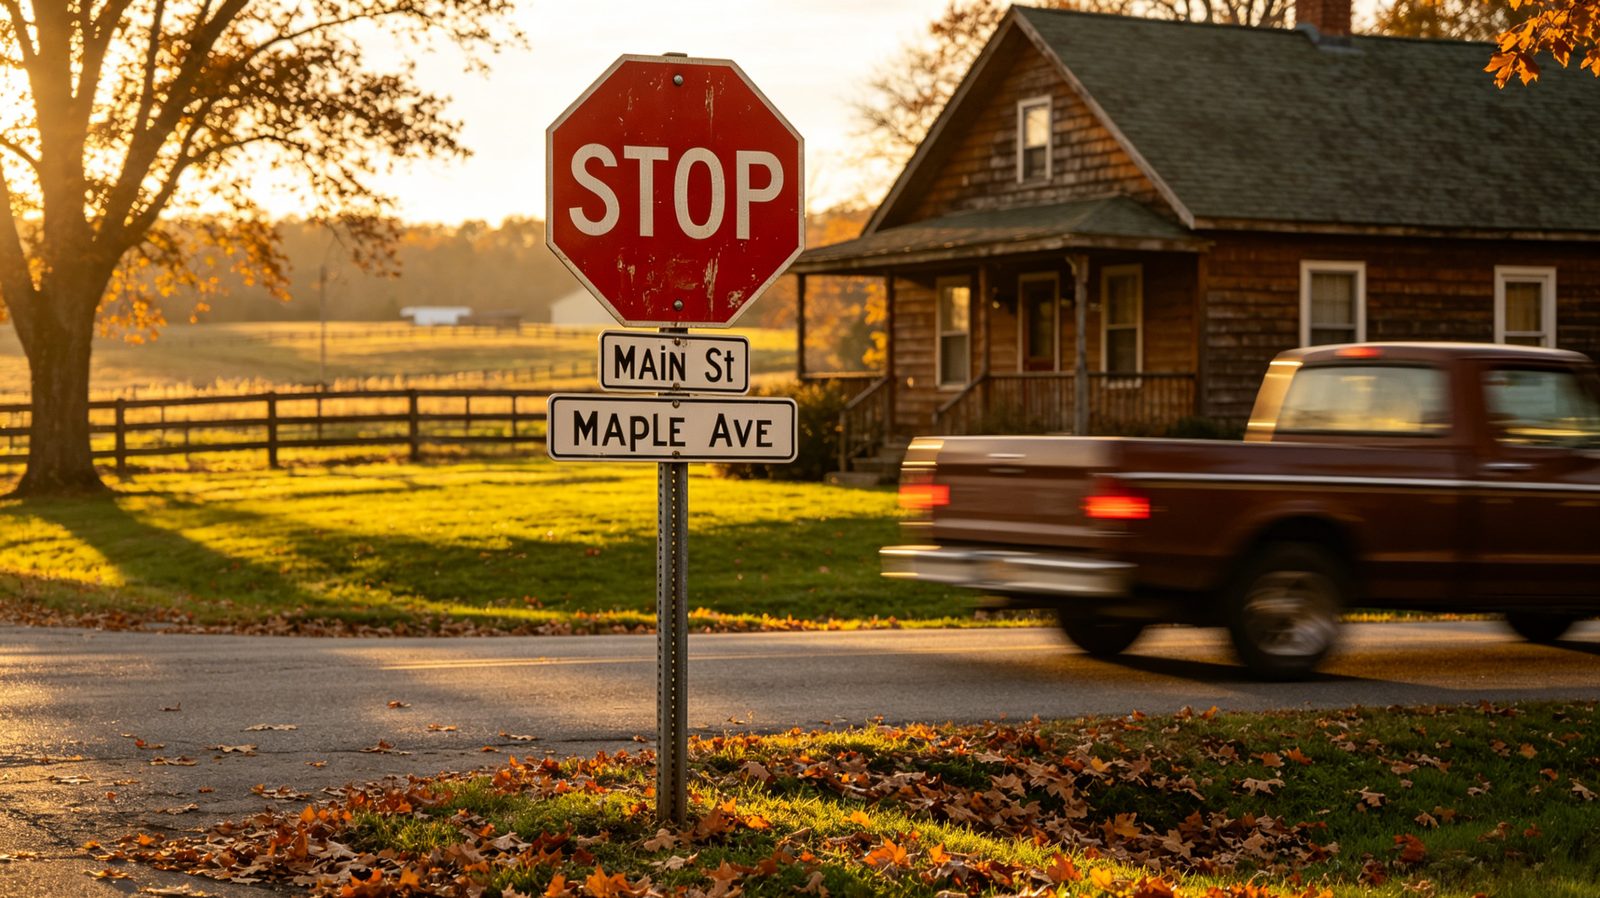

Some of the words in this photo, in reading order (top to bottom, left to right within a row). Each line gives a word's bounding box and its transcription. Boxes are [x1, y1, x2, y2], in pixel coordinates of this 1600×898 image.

[568, 143, 784, 240] STOP
[704, 347, 735, 383] St
[708, 413, 773, 448] AVE
